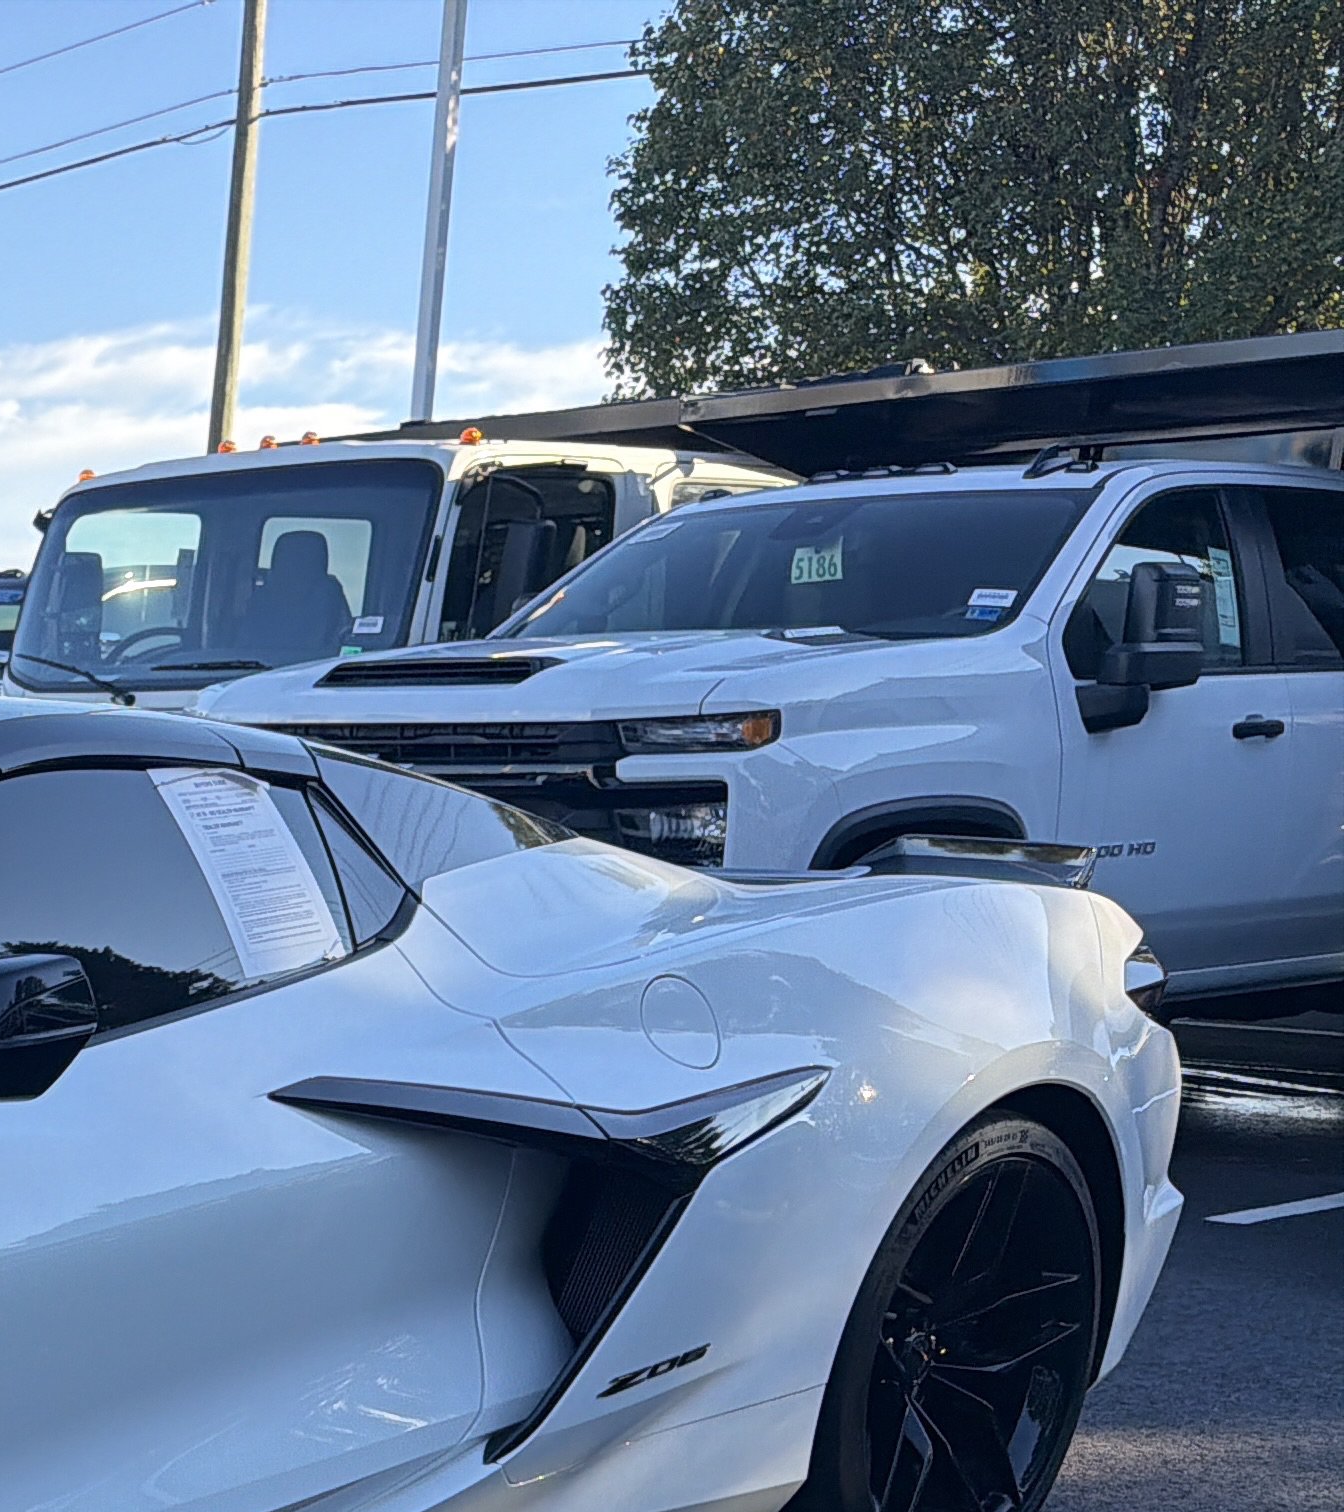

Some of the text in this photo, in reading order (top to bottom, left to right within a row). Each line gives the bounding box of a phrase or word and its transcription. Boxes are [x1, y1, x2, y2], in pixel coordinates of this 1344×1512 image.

[794, 554, 838, 581] 5186
[1096, 842, 1156, 859] 00 HD
[912, 1143, 978, 1221] MICHELIN
[596, 1342, 712, 1399] Z06
